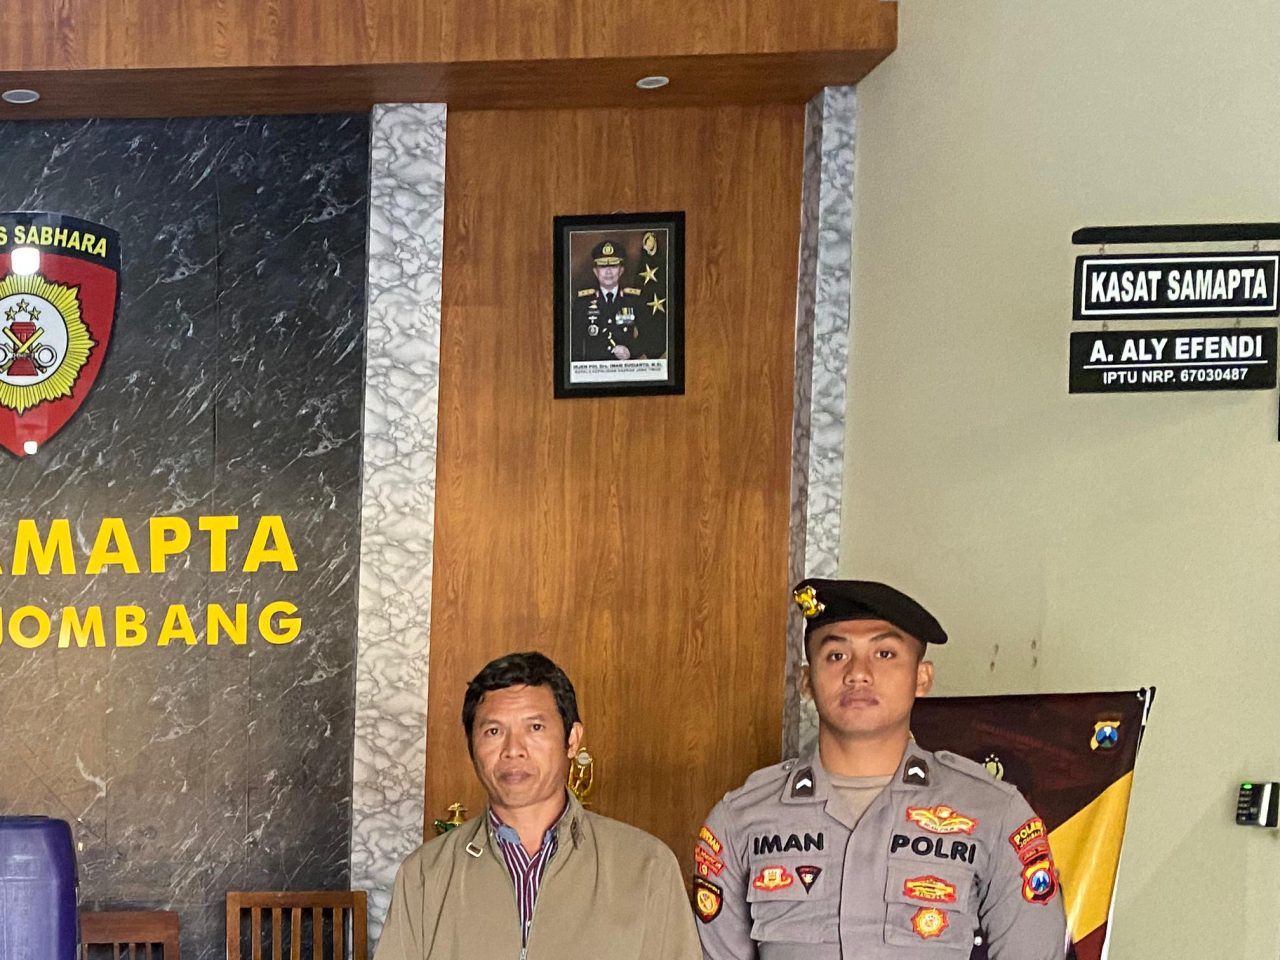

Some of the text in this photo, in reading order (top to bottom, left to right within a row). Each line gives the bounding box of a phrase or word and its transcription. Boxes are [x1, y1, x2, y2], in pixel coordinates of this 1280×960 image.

[14, 225, 107, 258] SABHARA
[1091, 268, 1268, 303] KASAT SAMAPTA
[1089, 335, 1263, 362] A. ALY EFENDI
[1103, 368, 1249, 385] IPTU NRP. 67030487
[753, 832, 824, 855] IMAN
[891, 834, 976, 864] POLRI
